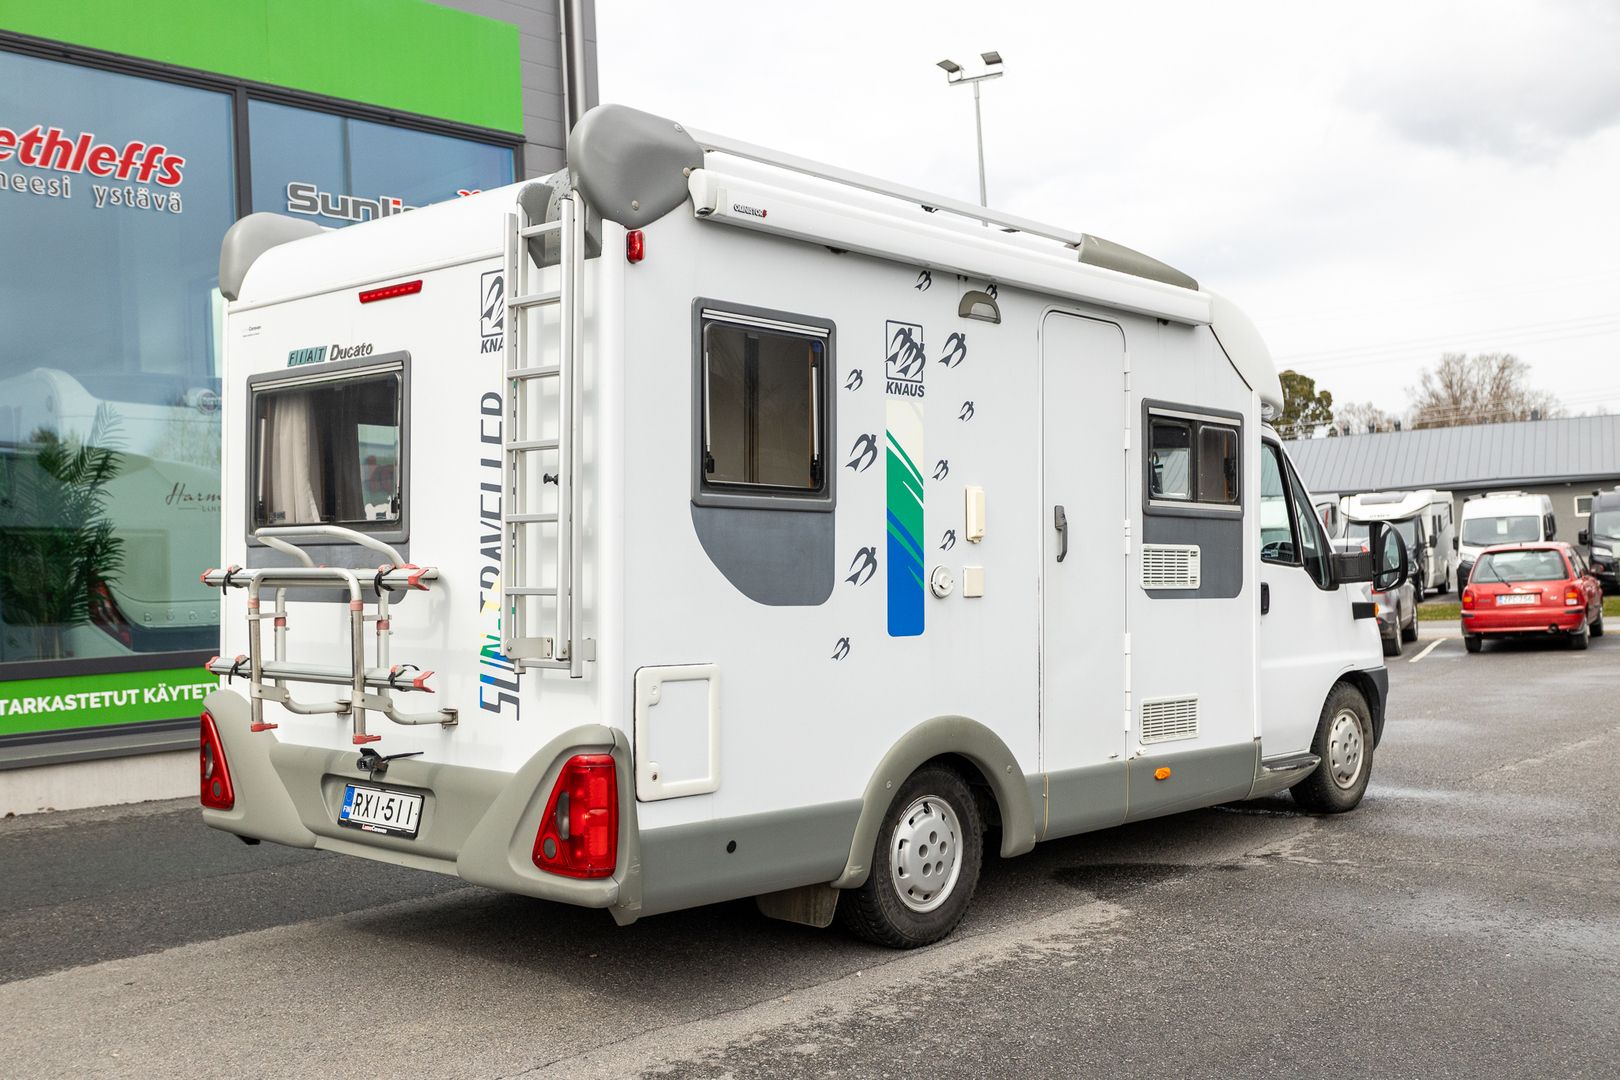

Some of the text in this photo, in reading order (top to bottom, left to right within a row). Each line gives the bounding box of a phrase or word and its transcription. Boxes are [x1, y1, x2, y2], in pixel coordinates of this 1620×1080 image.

[0, 125, 185, 187] ethleffs
[93, 184, 182, 213] ystävä
[287, 182, 415, 221] Sunli
[288, 343, 373, 366] FIAT Ducato
[480, 337, 503, 354] KNA
[886, 381, 925, 398] KNAUS
[165, 482, 221, 505] Harm
[0, 689, 139, 716] TARKASTETUT
[353, 793, 413, 825] RXI-511
